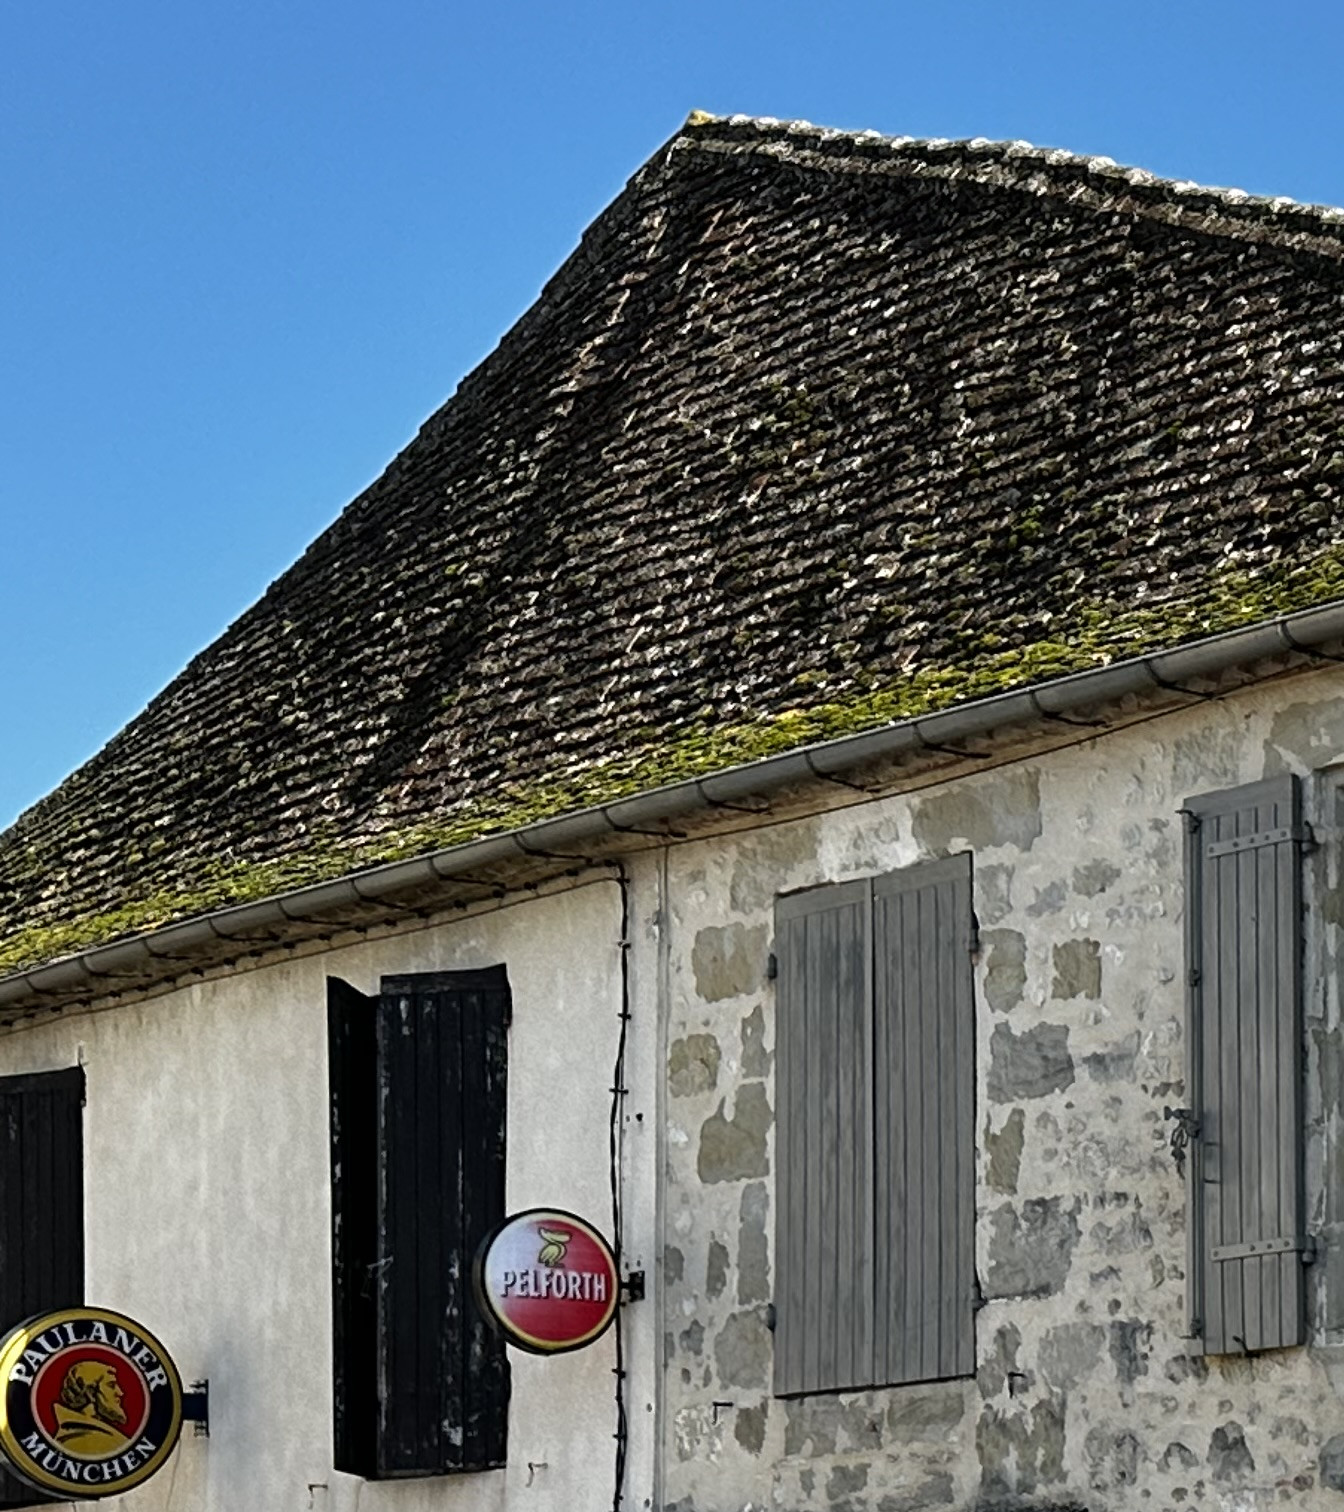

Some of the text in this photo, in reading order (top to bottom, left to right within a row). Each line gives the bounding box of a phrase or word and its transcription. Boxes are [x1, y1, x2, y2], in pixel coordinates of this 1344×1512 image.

[500, 1268, 607, 1303] PELFORTH
[9, 1321, 168, 1392] PAULANER
[20, 1431, 157, 1483] MÜNCHEN
